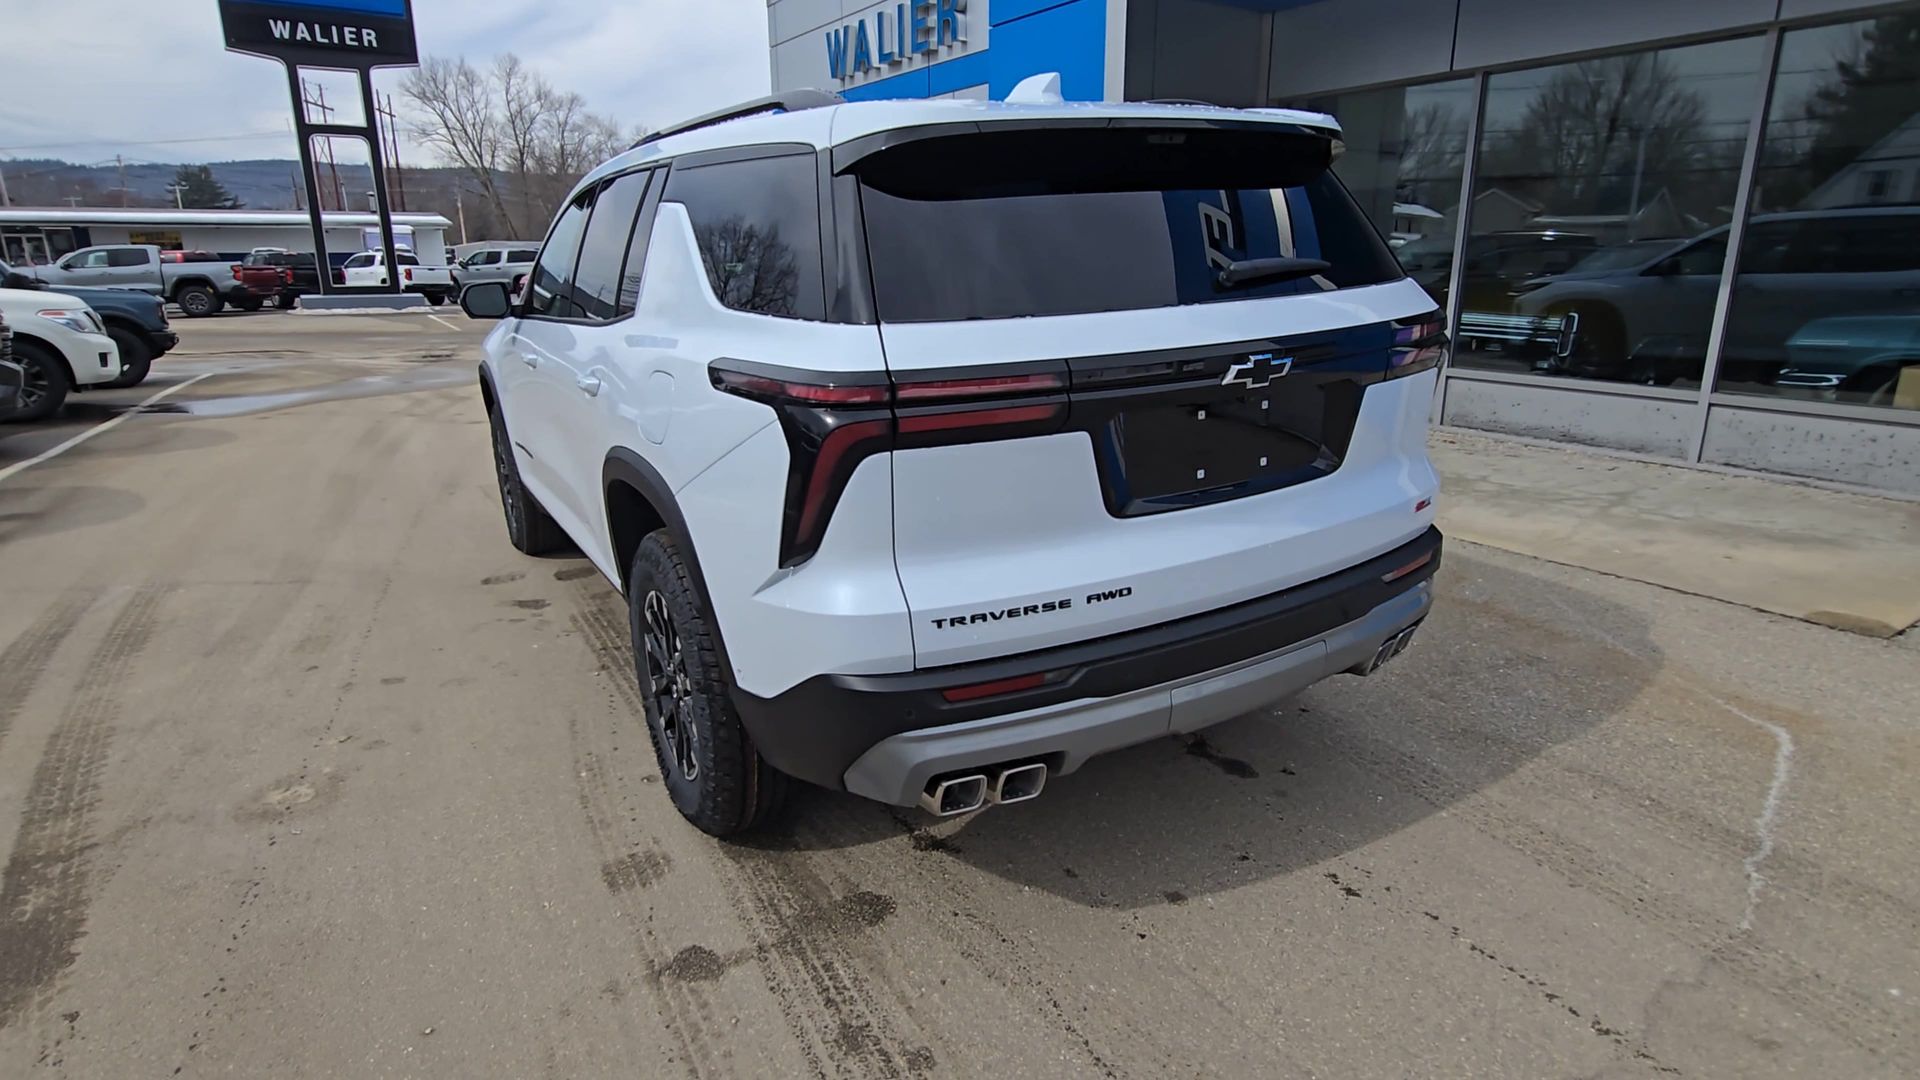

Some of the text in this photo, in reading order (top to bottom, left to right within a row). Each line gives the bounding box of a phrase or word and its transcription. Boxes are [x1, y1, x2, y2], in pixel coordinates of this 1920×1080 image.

[268, 18, 378, 48] WALIER
[826, 0, 966, 80] WALIER
[931, 586, 1133, 629] TRAVERSE AWD
